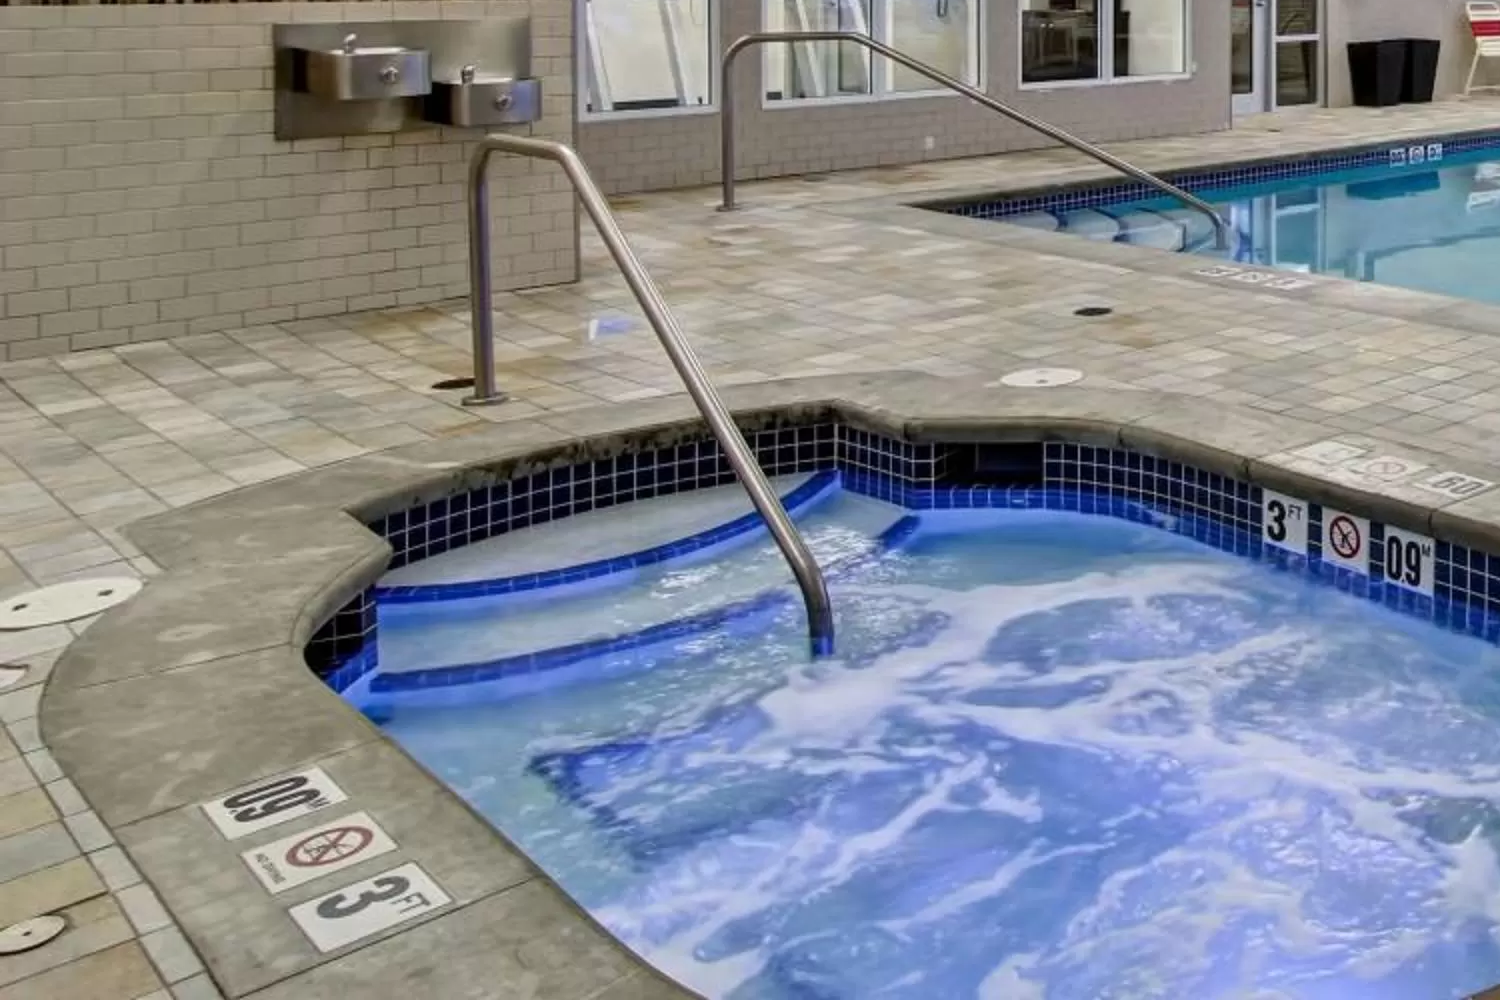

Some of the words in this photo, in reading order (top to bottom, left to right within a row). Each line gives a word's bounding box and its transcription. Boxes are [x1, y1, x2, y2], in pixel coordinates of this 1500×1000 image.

[1267, 500, 1287, 542] 3
[1288, 504, 1302, 521] FT
[1387, 535, 1421, 586] 0.9
[223, 775, 321, 823] 0.9
[316, 875, 411, 920] 3
[390, 891, 432, 915] FT
